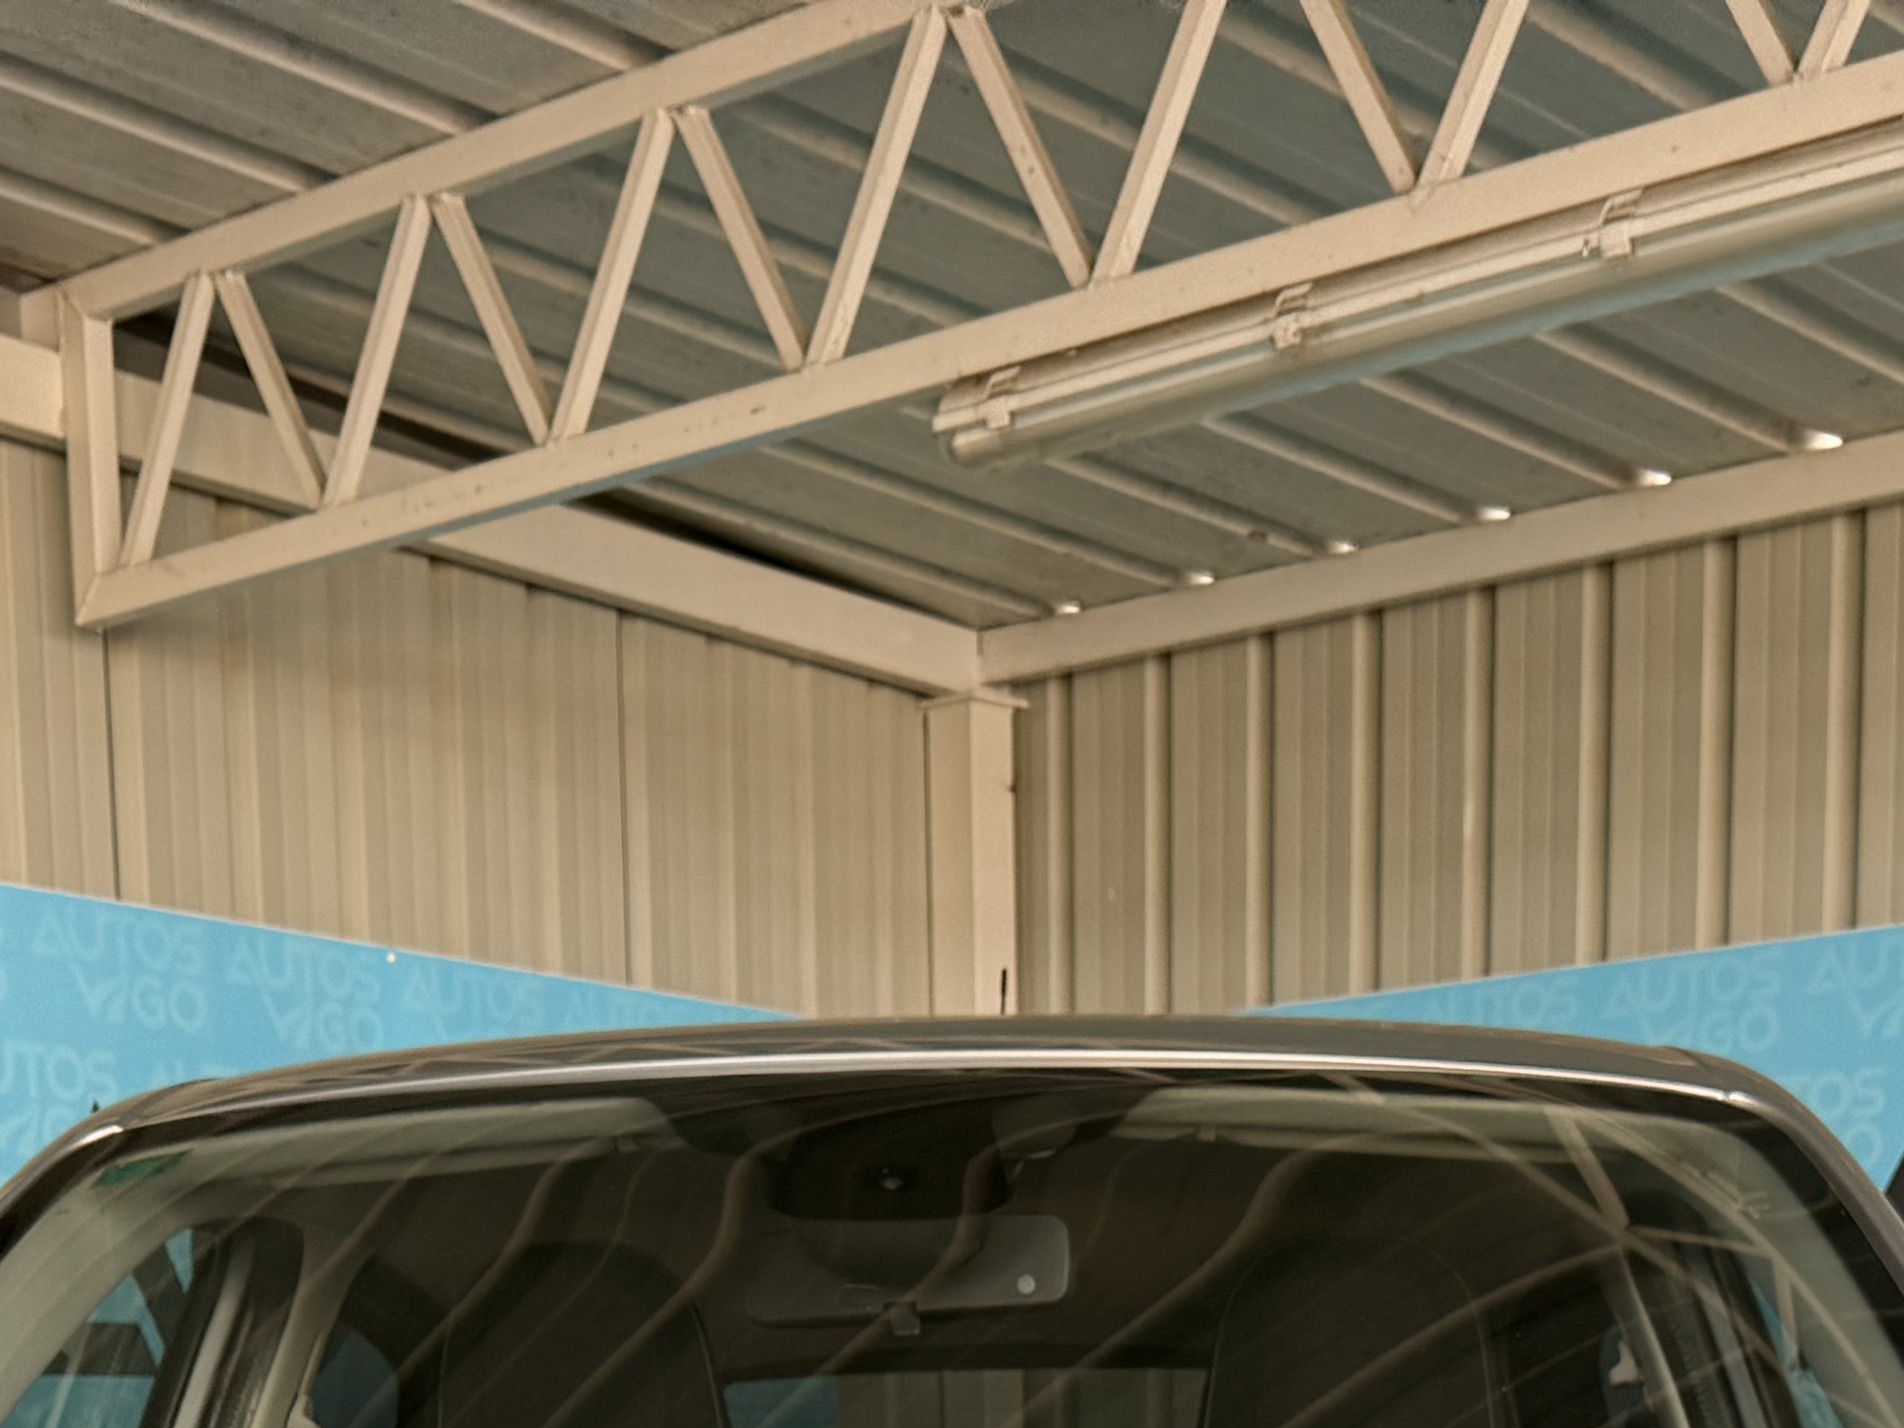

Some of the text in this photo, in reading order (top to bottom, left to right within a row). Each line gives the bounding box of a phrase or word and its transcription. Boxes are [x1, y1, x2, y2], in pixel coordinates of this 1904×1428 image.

[31, 904, 204, 974] AUTOS
[225, 932, 382, 1002] AUTOS
[69, 955, 208, 1035] VIGO
[1603, 952, 1782, 1019] AUTOS
